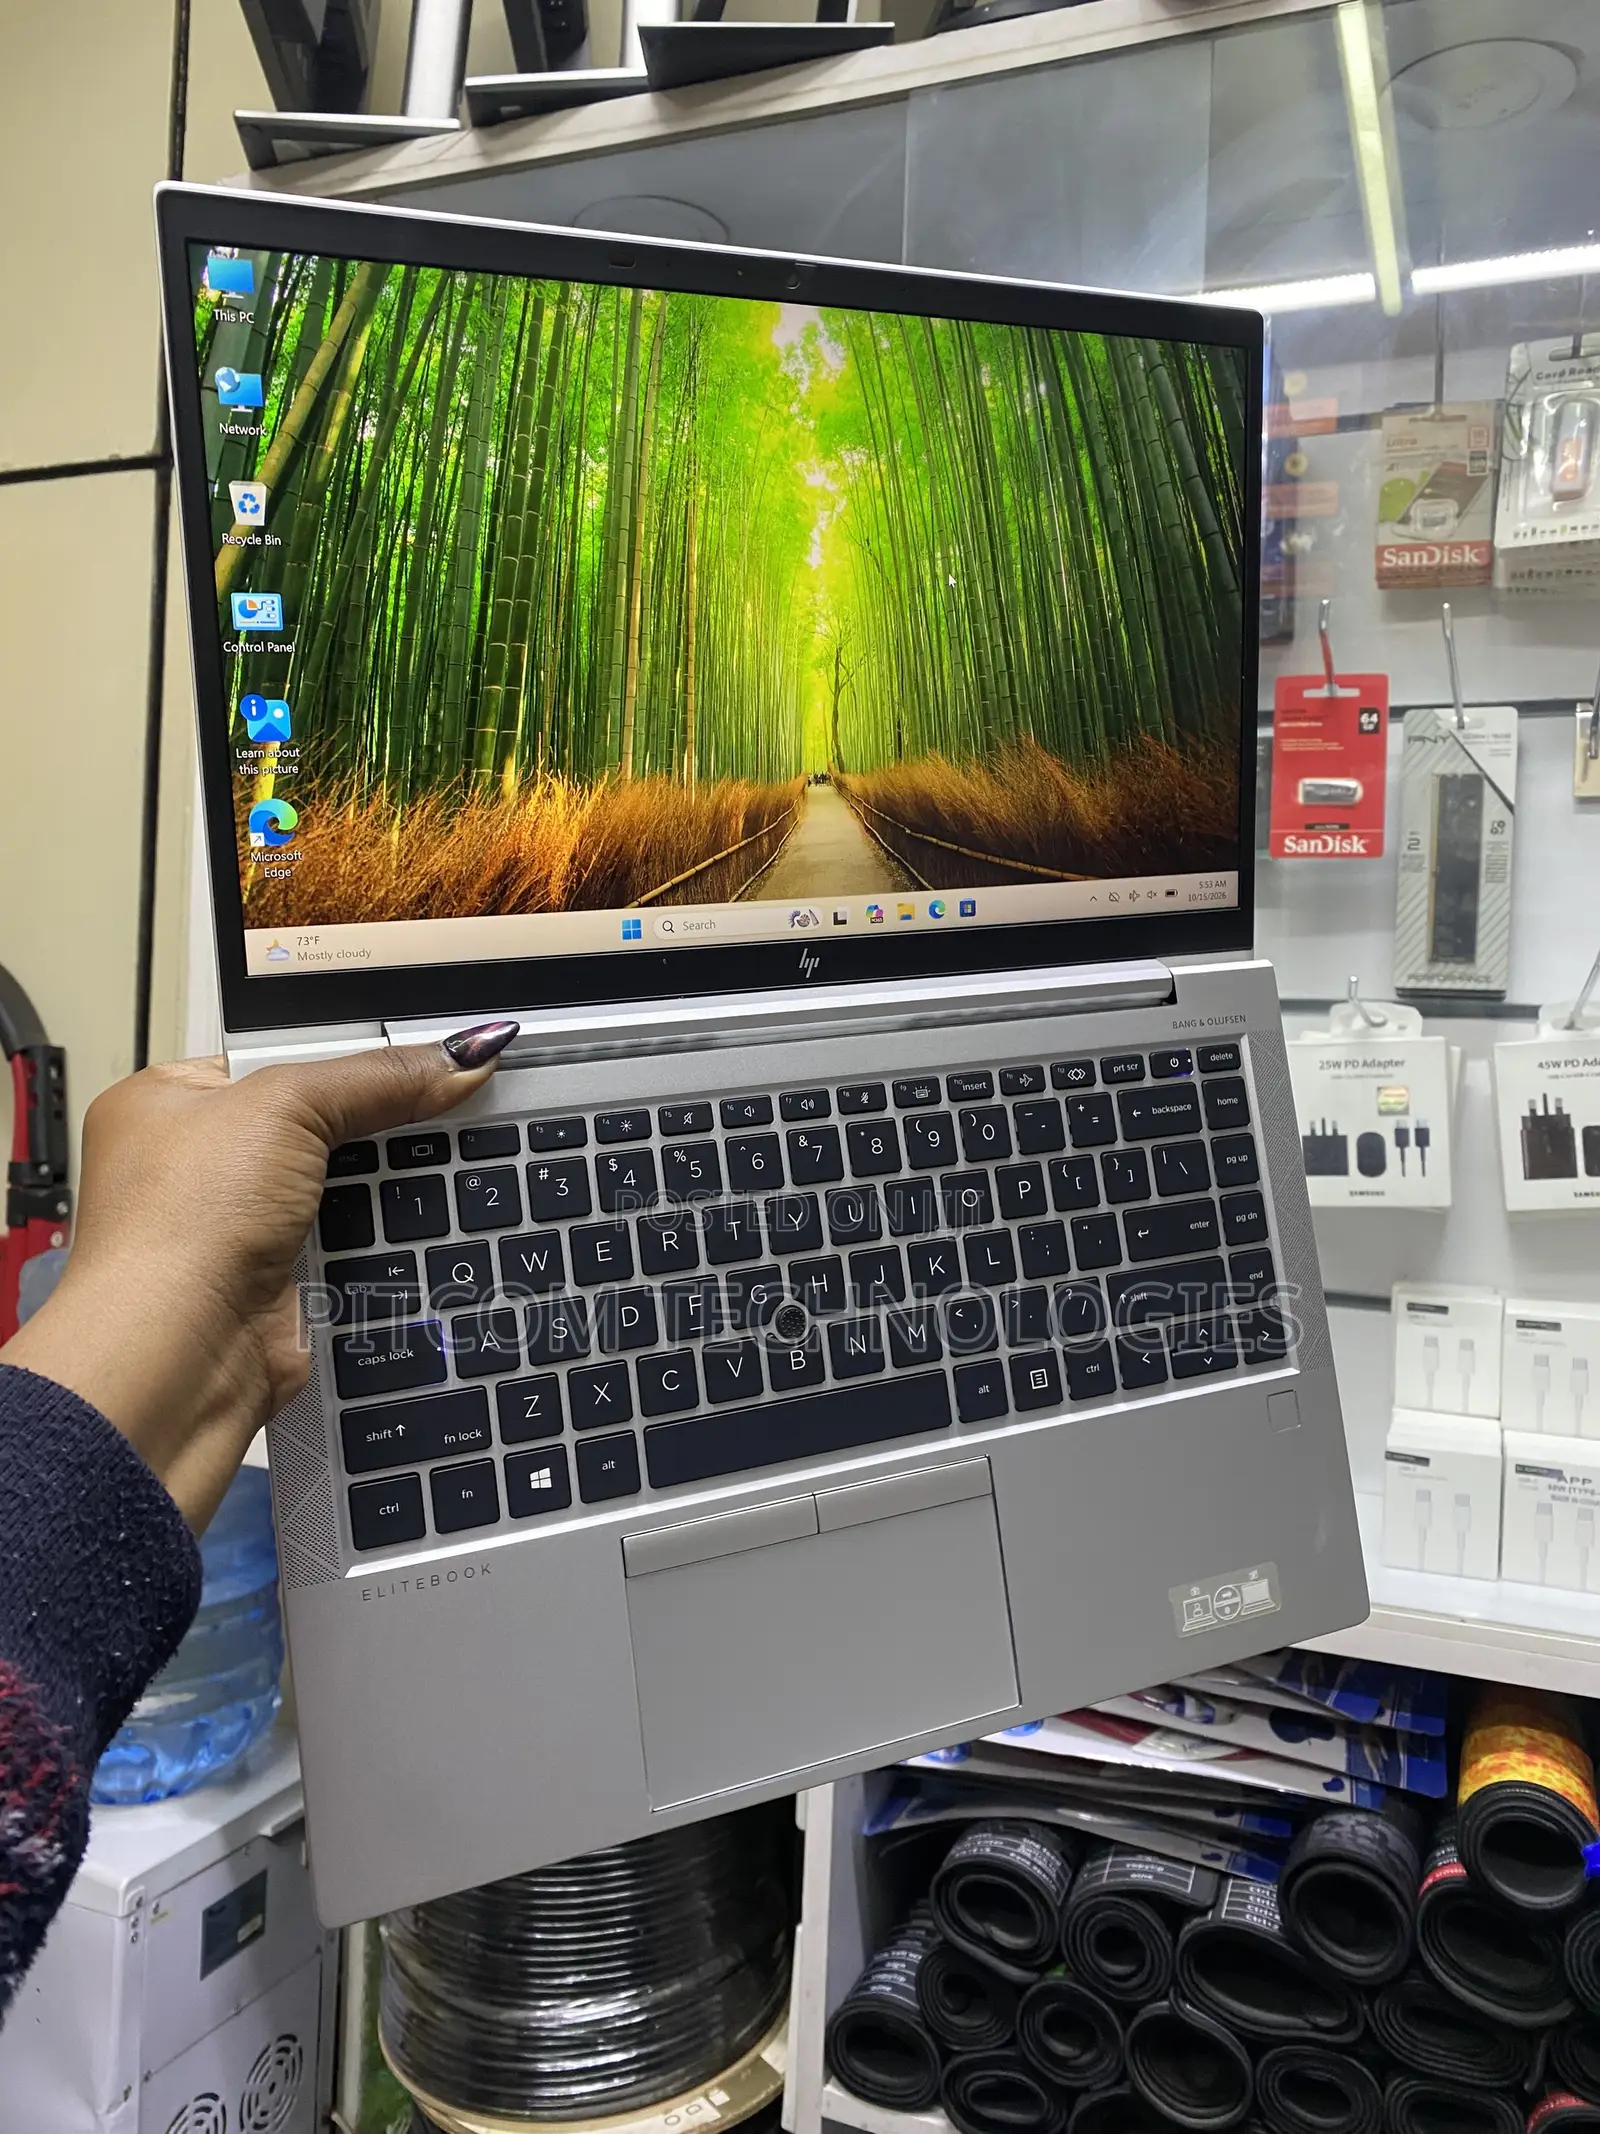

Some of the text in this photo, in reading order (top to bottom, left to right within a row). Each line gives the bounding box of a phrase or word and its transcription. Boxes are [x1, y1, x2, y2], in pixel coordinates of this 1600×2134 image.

[212, 308, 255, 324] This PC
[218, 423, 267, 437] Network
[221, 533, 282, 547] Recycle Bin
[1381, 545, 1481, 568] SanDisk
[223, 641, 296, 654] Control Panel
[236, 748, 300, 759] Learn about
[239, 764, 299, 776] this picture
[1283, 835, 1367, 854] SanDisk
[250, 850, 302, 863] Microsoft
[264, 867, 292, 880] Edge
[1214, 880, 1227, 888] AM
[682, 918, 716, 931] Search
[296, 935, 320, 947] 73°F
[297, 948, 372, 962] Mostly cloudy
[1172, 1014, 1247, 1029] BANG & OLUFSEN
[1209, 1051, 1234, 1063] delete
[1318, 1059, 1406, 1072] 25W PD Adapter
[1564, 1059, 1580, 1068] PD
[1112, 1062, 1139, 1075] prt scr
[962, 1080, 988, 1093] insert
[1151, 1101, 1192, 1116] backspace
[1217, 1096, 1239, 1106] home
[870, 1137, 884, 1155] 8
[928, 1131, 940, 1148] 9
[673, 1150, 687, 1163] %
[751, 1152, 765, 1170] 6
[811, 1145, 823, 1163] 7
[1226, 1153, 1248, 1164] pg up
[608, 1157, 618, 1173] $
[690, 1160, 702, 1178] 5
[465, 1175, 482, 1191] @
[538, 1168, 549, 1181] #
[623, 1169, 637, 1187] 4
[556, 1178, 569, 1196] 3
[1018, 1180, 1031, 1199] P
[486, 1187, 499, 1206] 2
[961, 1188, 978, 1207] O
[414, 1197, 422, 1216] 1
[848, 1204, 864, 1223] U
[787, 1212, 803, 1232] Y
[1189, 1219, 1210, 1230] enter
[1236, 1210, 1258, 1224] pg dn
[727, 1221, 741, 1241] T
[662, 1231, 679, 1251] R
[596, 1240, 613, 1262] E
[986, 1248, 1000, 1266] L
[520, 1250, 548, 1273] W
[928, 1256, 946, 1276] K
[452, 1262, 474, 1284] Q
[874, 1265, 884, 1285] J
[1248, 1270, 1264, 1281] end
[346, 1283, 367, 1295] tab
[811, 1273, 829, 1294] H
[750, 1284, 768, 1304] G
[1130, 1292, 1148, 1303] shift
[688, 1294, 703, 1316] F
[621, 1306, 639, 1327] D
[552, 1318, 568, 1339] S
[907, 1323, 926, 1345] M
[480, 1330, 500, 1352] A
[849, 1335, 867, 1356] N
[357, 1348, 415, 1368] caps lock
[790, 1350, 806, 1370] B
[726, 1356, 743, 1378] V
[1086, 1362, 1100, 1374] ctrl
[662, 1370, 680, 1391] C
[593, 1382, 612, 1405] X
[978, 1384, 990, 1395] alt
[523, 1395, 541, 1418] Z
[366, 1428, 393, 1442] shift
[444, 1429, 482, 1444] fn lock
[601, 1459, 616, 1471] alt
[461, 1488, 473, 1499] fn
[378, 1502, 400, 1516] ctrl
[361, 1562, 492, 1601] ELITEBOOK
